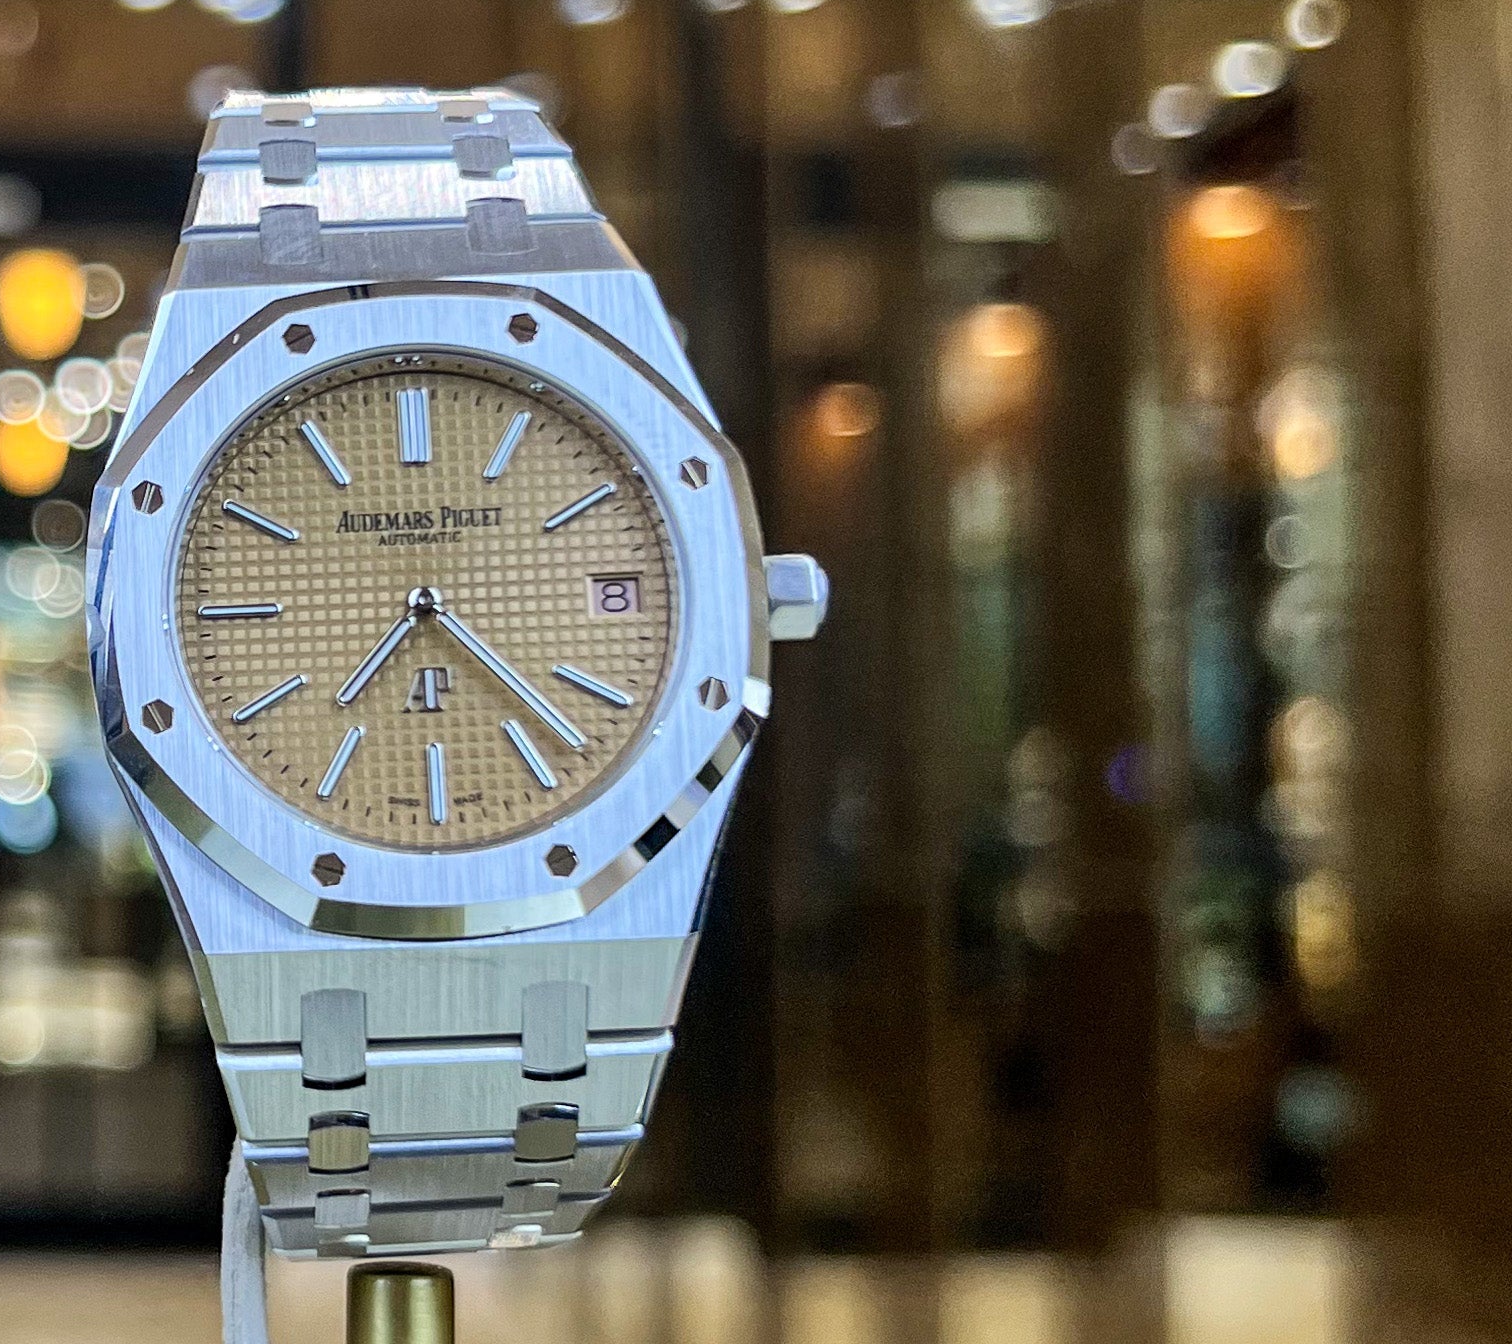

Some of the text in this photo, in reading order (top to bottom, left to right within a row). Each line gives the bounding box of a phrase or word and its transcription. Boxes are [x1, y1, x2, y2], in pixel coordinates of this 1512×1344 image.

[336, 506, 502, 534] AUDEMARS PIGUET
[378, 531, 462, 547] AUTOMATIC
[602, 582, 629, 613] 8
